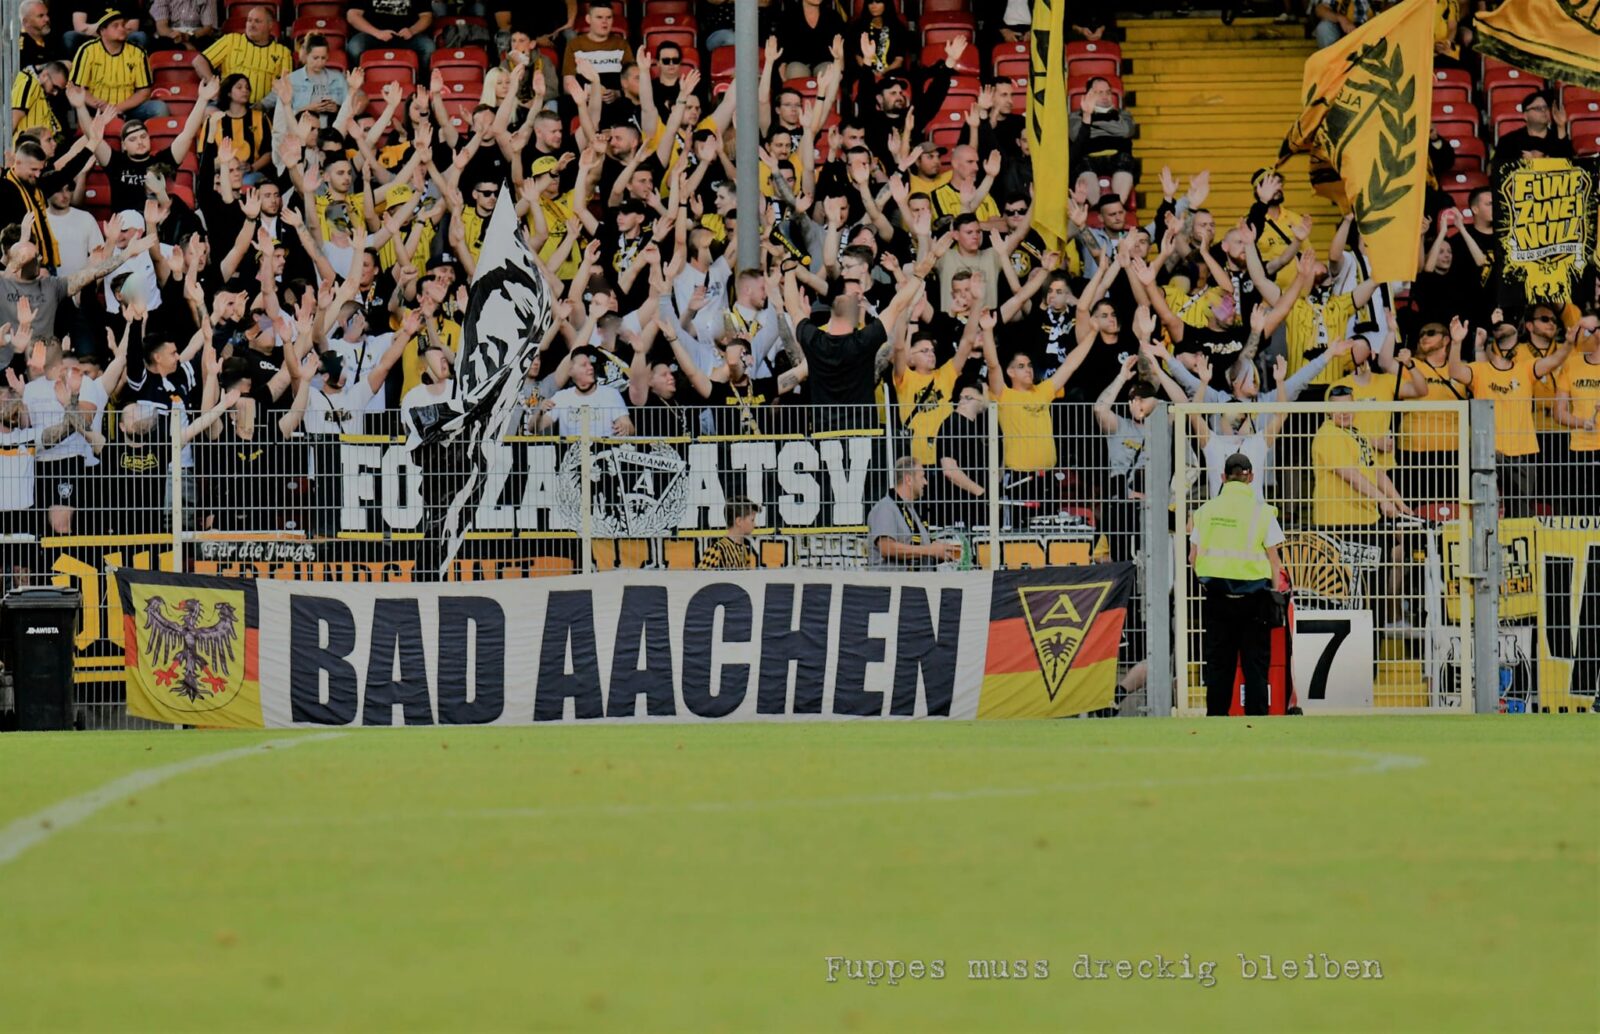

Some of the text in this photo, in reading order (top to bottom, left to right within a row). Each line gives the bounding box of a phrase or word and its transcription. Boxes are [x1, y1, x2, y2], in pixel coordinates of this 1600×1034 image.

[1515, 192, 1583, 225] ZWEI
[1514, 217, 1580, 251] NULL
[617, 451, 680, 470] ALEMANNIA
[340, 437, 873, 530] FOZA ATSV
[204, 541, 236, 558] Für
[239, 541, 264, 559] die
[290, 593, 506, 726] BAD
[532, 582, 963, 722] AACHEN
[1296, 620, 1351, 700] 7
